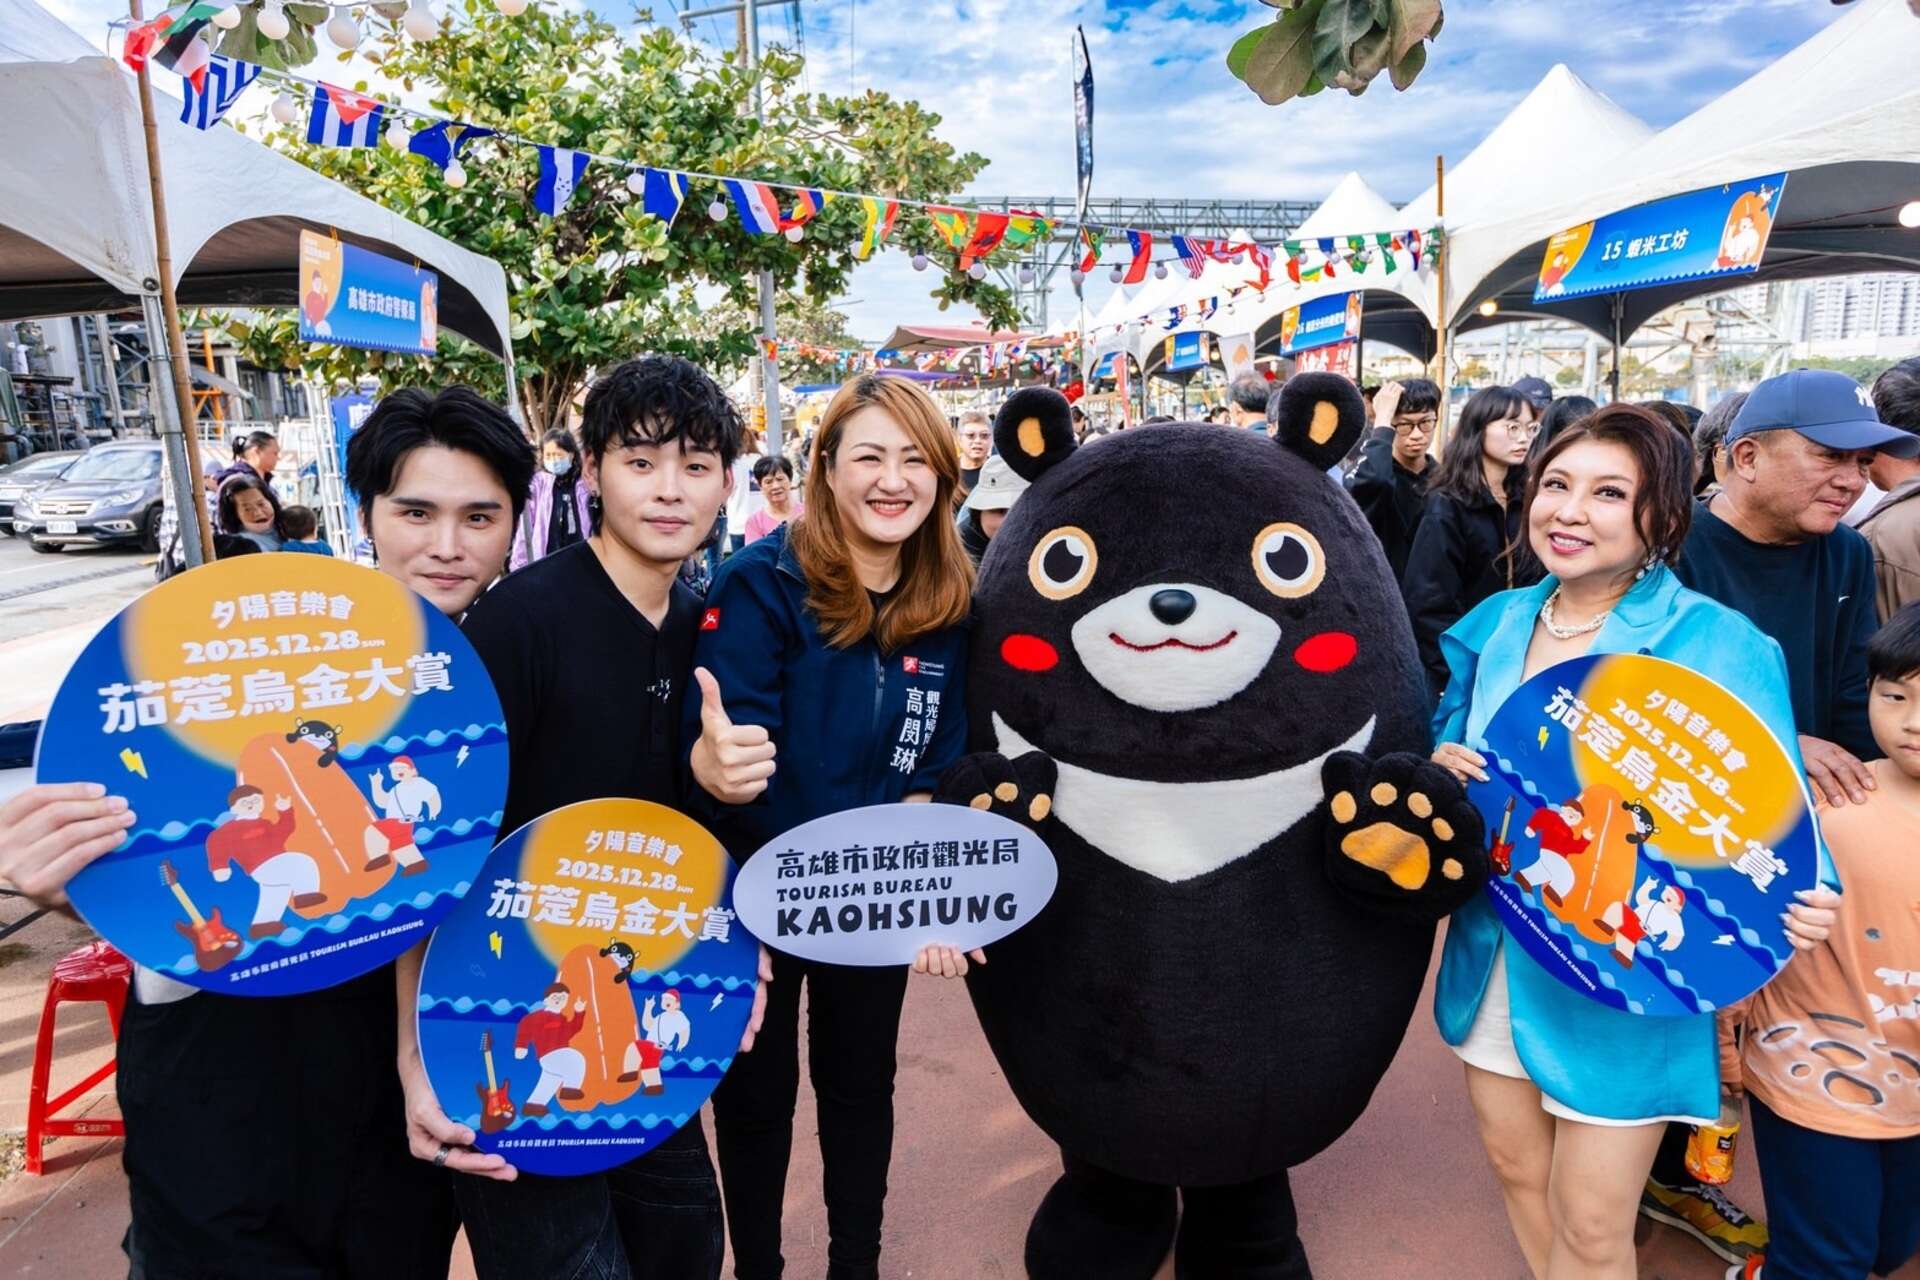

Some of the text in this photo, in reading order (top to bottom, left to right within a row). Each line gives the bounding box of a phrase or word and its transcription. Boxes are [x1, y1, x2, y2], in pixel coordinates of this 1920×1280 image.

[1601, 242, 1623, 261] 15
[211, 590, 354, 629] 夕陽音樂會
[182, 630, 361, 664] 2025.12.28
[97, 651, 454, 734] 茄萣烏金大賞
[890, 686, 924, 775] 高閔琳
[1609, 698, 1731, 797] 2025.12.28
[1644, 689, 1749, 772] 夕陽音樂會
[1544, 686, 1789, 894] 茄萣烏金大賞
[585, 830, 684, 866] 夕陽音樂會
[776, 838, 1020, 879] 高雄市政府觀光局
[555, 858, 678, 891] 2025.12.28
[777, 876, 953, 903] TOURISM BUREAU
[486, 878, 736, 943] 茄萣烏金大賞
[776, 892, 1018, 937] KAOHSIUNG
[310, 941, 348, 959] TOURISM
